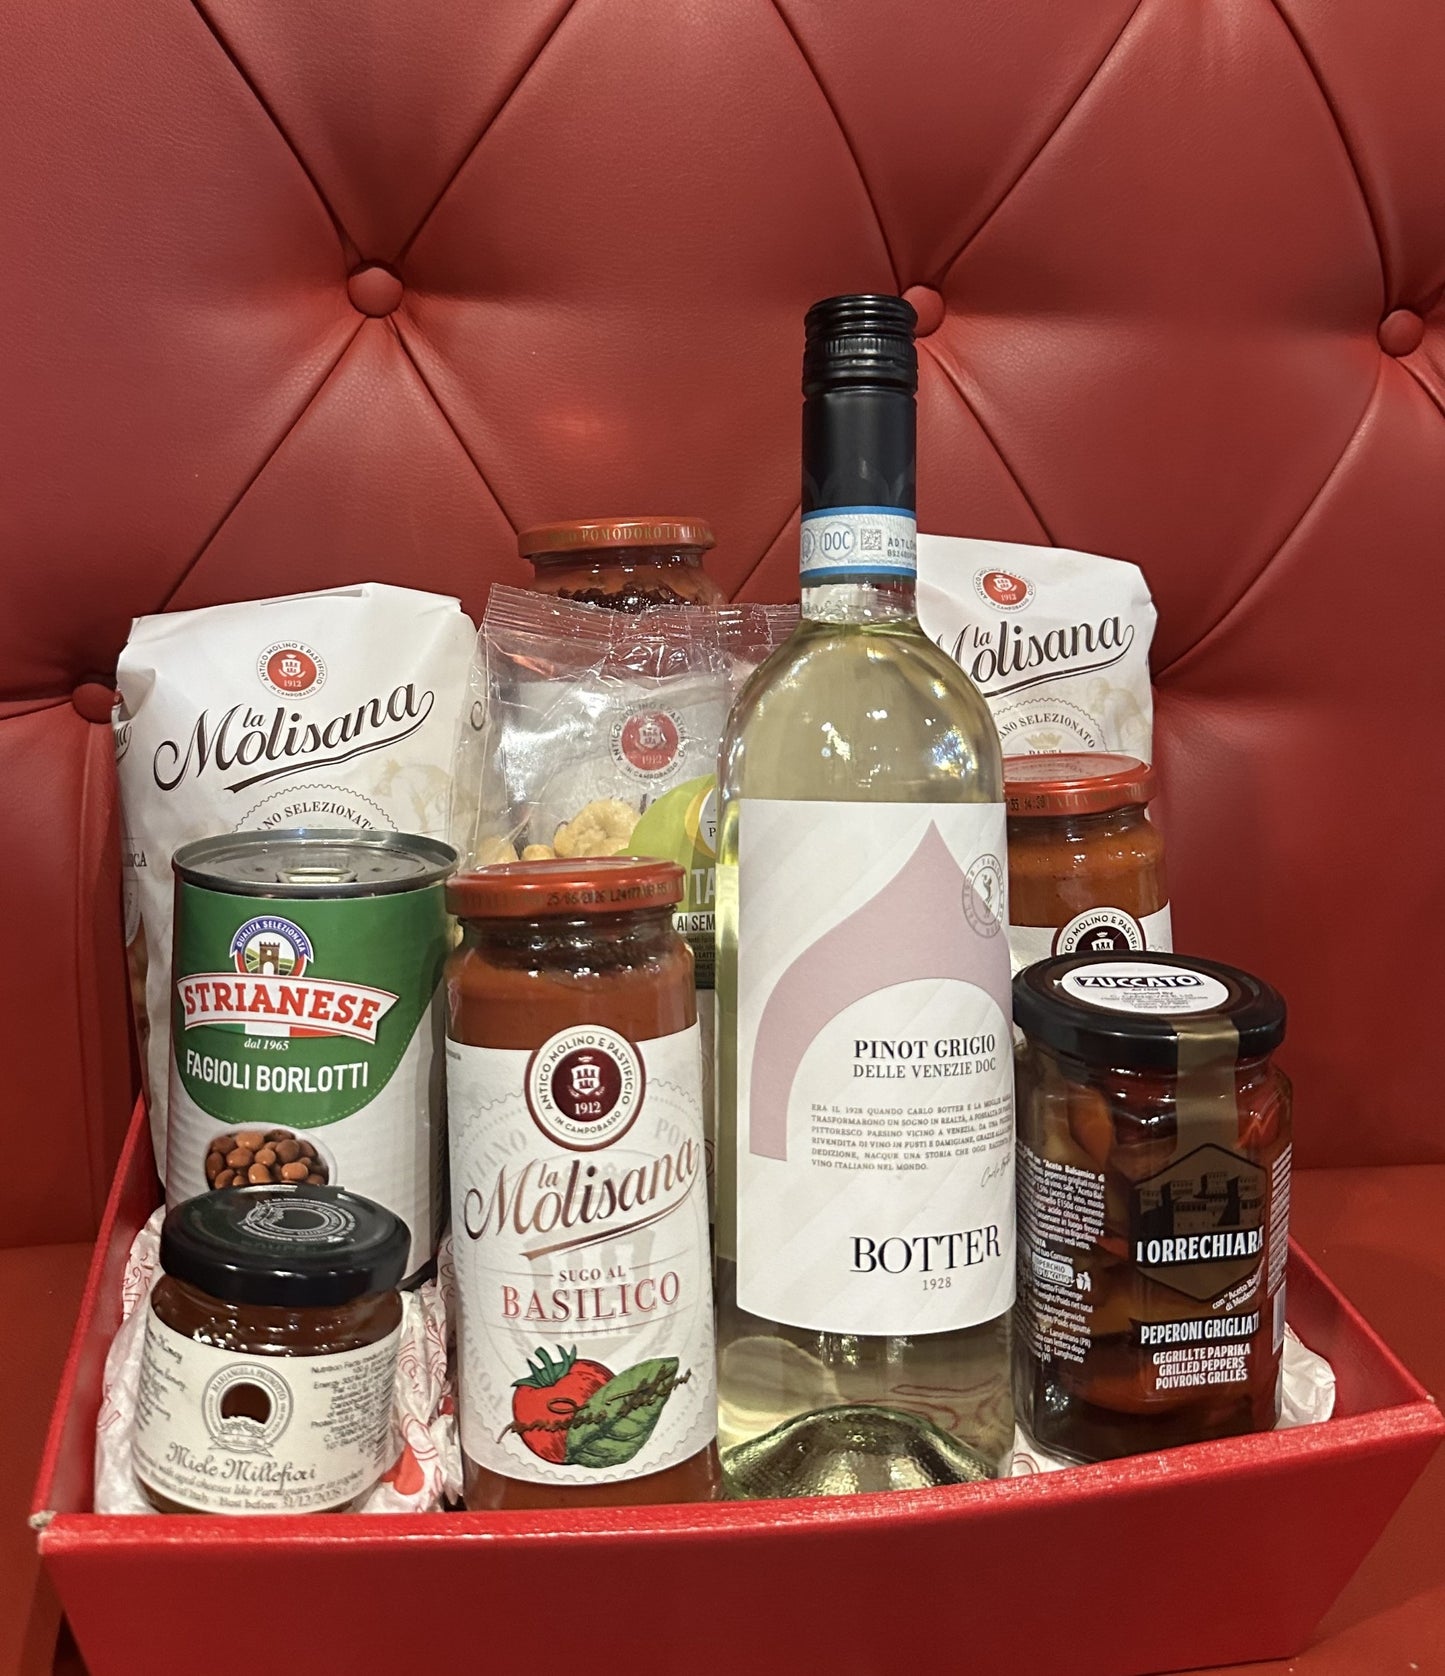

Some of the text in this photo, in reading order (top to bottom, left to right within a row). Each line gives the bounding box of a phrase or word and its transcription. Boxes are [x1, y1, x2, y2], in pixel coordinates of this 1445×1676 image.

[824, 531, 850, 551] DOC
[974, 626, 992, 648] la
[259, 654, 269, 681] ANTICO
[267, 642, 298, 655] MOLINO
[306, 649, 325, 685] PASTIFICIO
[276, 686, 316, 698] CAMPOBASSO
[284, 680, 302, 688] 1912
[242, 707, 266, 728] la
[154, 683, 435, 792] Molisana
[1020, 712, 1096, 749] SELEZIONATO
[677, 916, 688, 931] AI
[1072, 915, 1138, 950] MOLINO E PASTIFI
[236, 920, 306, 952] QUALITÀ SELEZIONATA
[1079, 975, 1197, 988] ZUCCATO
[184, 982, 381, 1031] STRIANESE
[244, 1037, 290, 1050] dal 1965
[854, 1034, 996, 1059] PINOT GRIGIO
[186, 1049, 369, 1093] FAGIOLI BORLOTTI
[539, 1035, 634, 1110] ANTICO MOLINO E PASTIFICIO
[854, 1057, 996, 1079] DELLE VENEZIE DOC
[574, 1101, 602, 1115] 1912
[867, 1108, 904, 1116] QUANDO
[906, 1107, 934, 1115] CARLO
[937, 1104, 964, 1114] BOTTER
[554, 1110, 622, 1134] IN CAMPOBASSO
[811, 1114, 886, 1126] TRASFORMARONO
[902, 1118, 928, 1126] SOGNO
[811, 1126, 862, 1136] PITTORESCO
[906, 1129, 934, 1137] VICINO
[811, 1137, 856, 1148] RIVENDITA
[858, 1140, 868, 1148] DI
[811, 1148, 860, 1160] DEDIZIONE,
[864, 1152, 898, 1160] NACQUE
[903, 1152, 920, 1160] UNA
[925, 1151, 952, 1159] STORIA
[955, 1148, 969, 1156] CHE
[538, 1163, 559, 1188] la
[811, 1160, 832, 1168] VINO
[834, 1162, 875, 1170] ITALIANO
[1064, 1164, 1096, 1180] Balsamico
[464, 1137, 701, 1240] Molisana
[850, 1224, 1001, 1274] BOTTER
[559, 1266, 626, 1282] SUGO AL
[922, 1276, 951, 1291] 1928
[502, 1271, 680, 1322] BASILICO
[1212, 1298, 1226, 1310] con
[1226, 1301, 1234, 1312] di
[1140, 1320, 1203, 1345] PEPERONI
[1152, 1342, 1250, 1366] GEGRILLTE PAPRIKA
[1159, 1356, 1245, 1377] GRILLED PEPPERS
[1156, 1366, 1248, 1390] POIVRONS GRILLÉS
[166, 1442, 218, 1477] Miele
